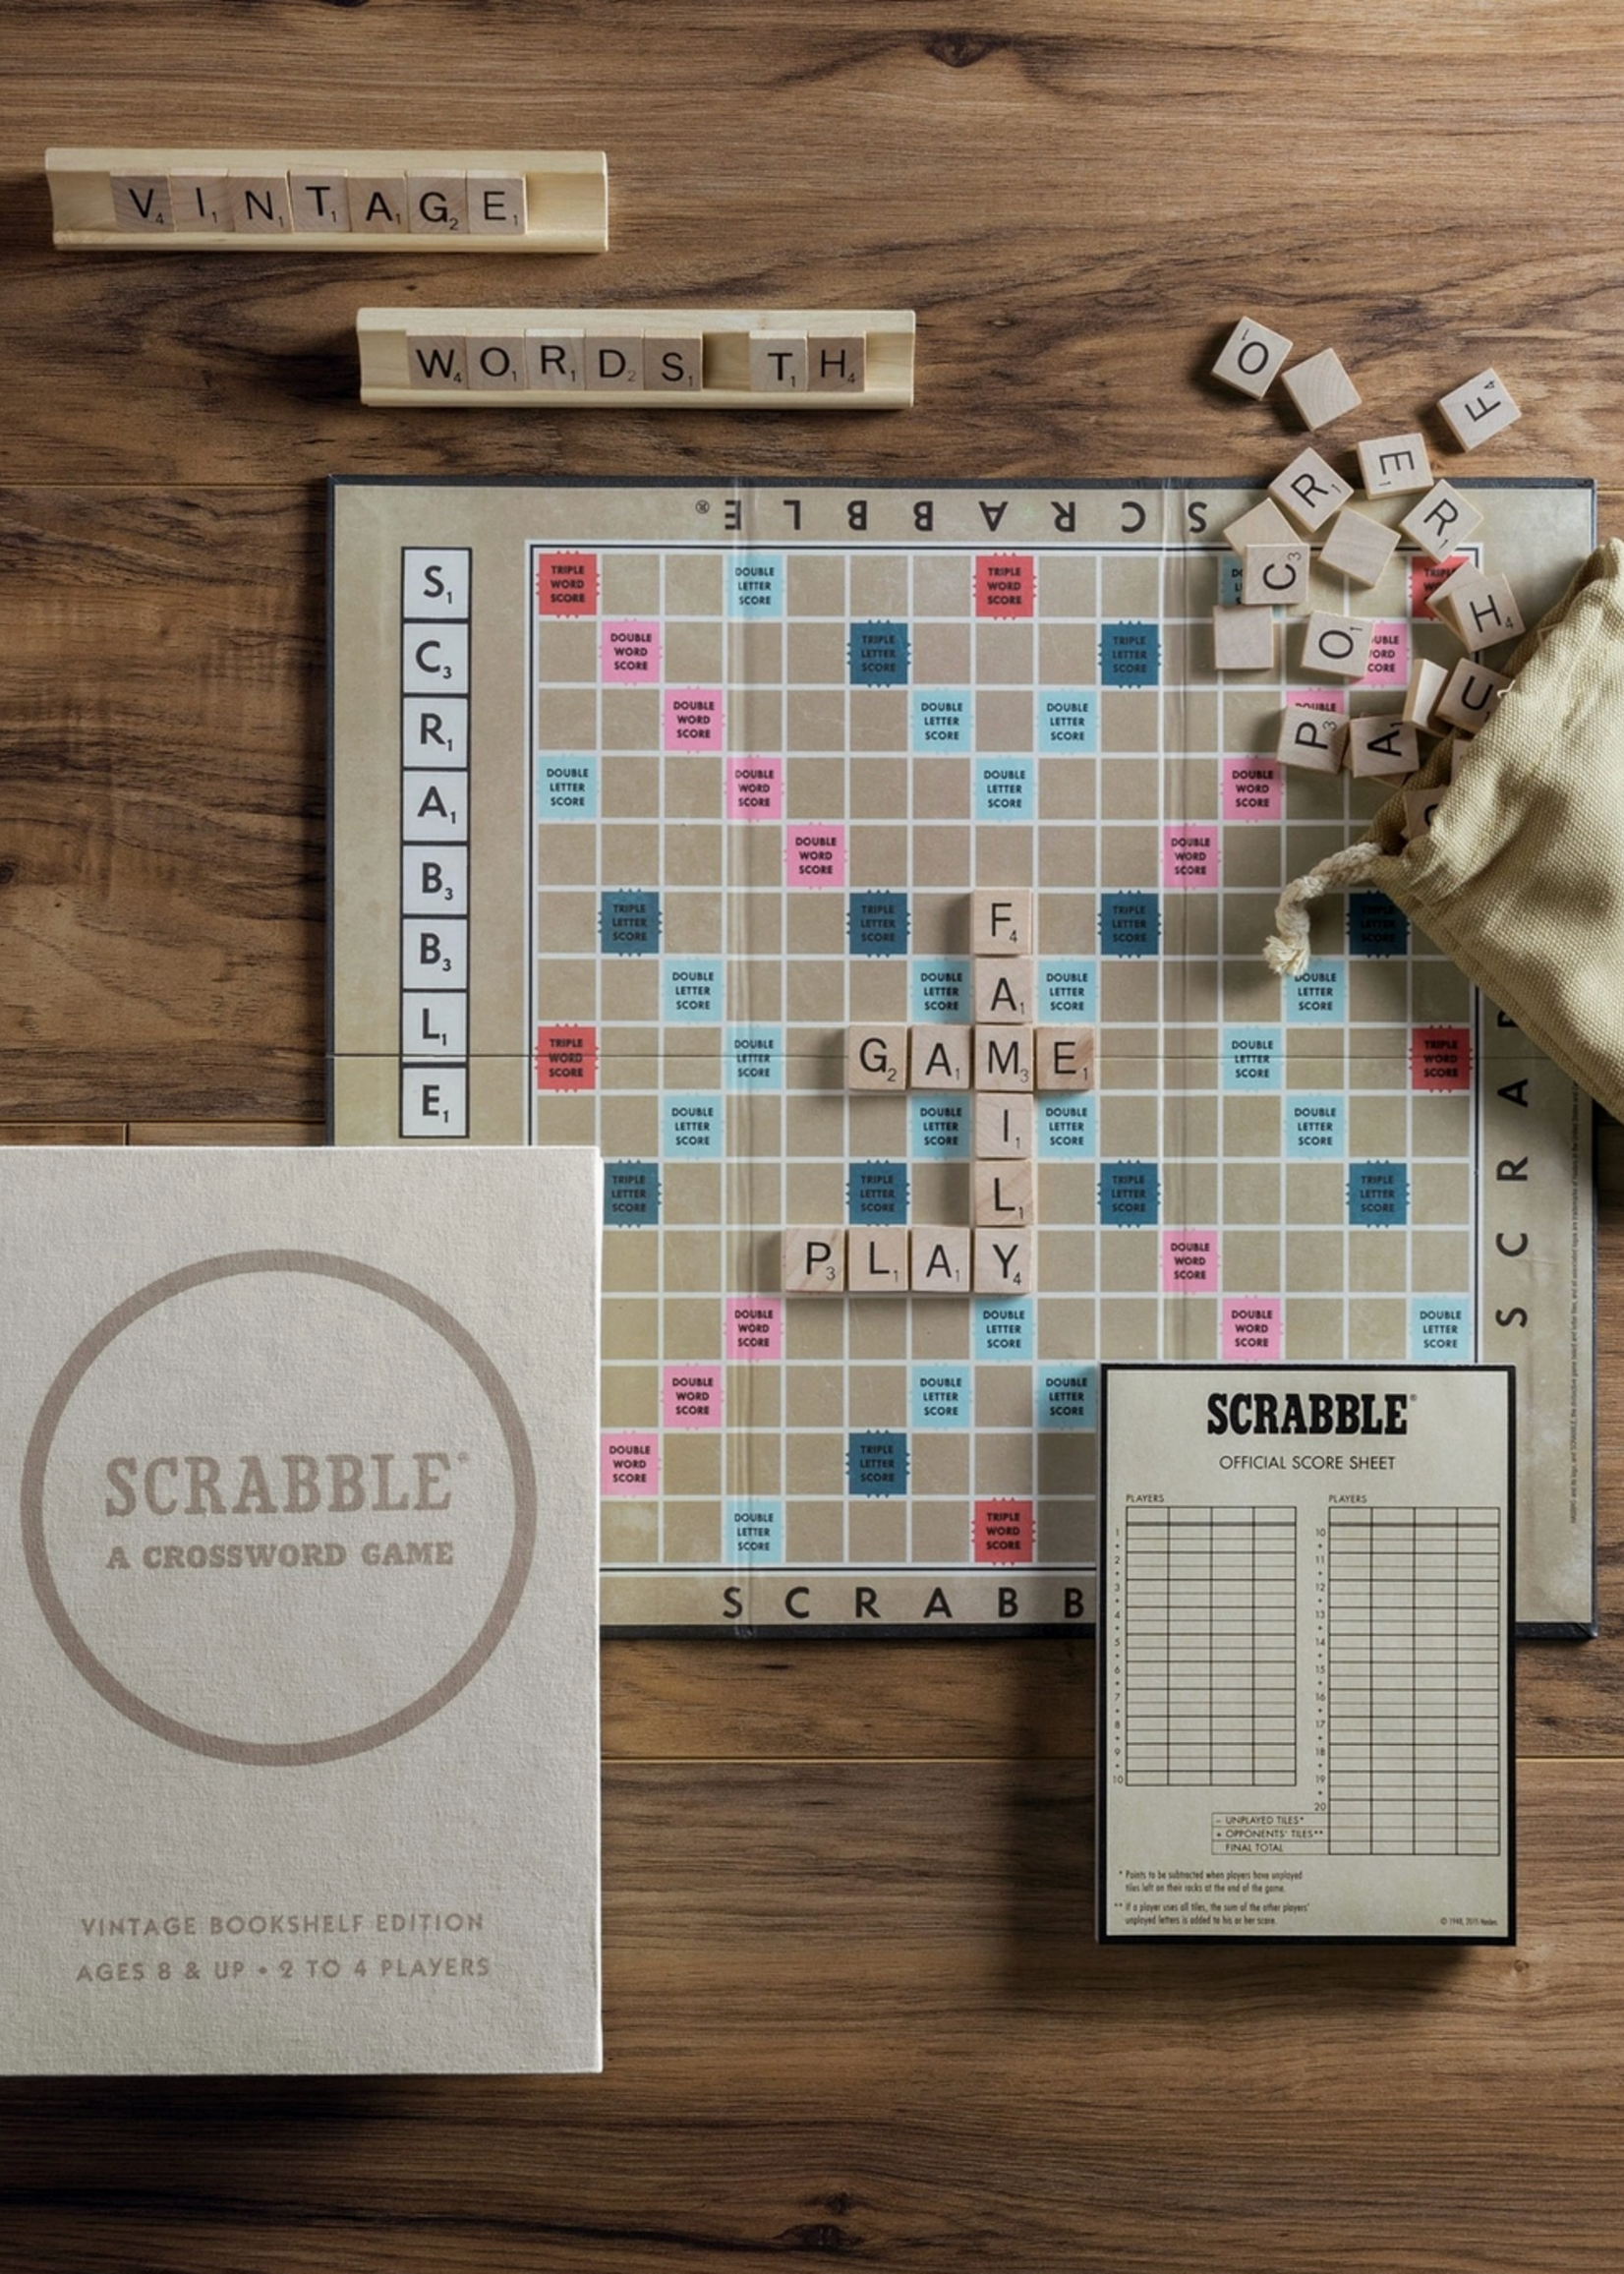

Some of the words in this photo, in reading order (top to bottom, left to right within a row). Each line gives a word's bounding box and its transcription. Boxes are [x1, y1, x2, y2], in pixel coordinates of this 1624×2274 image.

[551, 565, 585, 575] TRIPLE
[735, 566, 775, 577] DOUBLE
[987, 566, 1021, 577] TRIPLE
[550, 579, 585, 590] WORD
[737, 581, 772, 592] LETTER
[986, 581, 1021, 592] WORD
[550, 593, 586, 604] SCORE
[739, 595, 771, 606] SCORE
[987, 595, 1022, 606] SCORE
[609, 632, 652, 643] DOUBLE
[1113, 635, 1146, 646] TRIPLE
[613, 647, 648, 657] WORD
[1112, 650, 1147, 660] LETTER
[613, 661, 648, 671] SCORE
[1113, 663, 1147, 673] SCORE
[920, 702, 963, 713] DOUBLE
[924, 716, 959, 727] LETTER
[924, 730, 959, 740] SCORE
[546, 768, 589, 779] DOUBLE
[1231, 769, 1276, 781] DOUBLE
[550, 782, 586, 792] LETTER
[1235, 784, 1270, 794] WORD
[551, 796, 585, 807] SCORE
[1235, 797, 1270, 808] SCORE
[1171, 837, 1210, 847] DOUBLE
[1175, 851, 1207, 861] WORD
[1174, 865, 1207, 876] SCORE
[612, 904, 646, 913] TRIPLE
[611, 917, 648, 928] LETTER
[612, 931, 648, 942] SCORE
[671, 971, 714, 981] DOUBLE
[675, 985, 711, 996] LETTER
[675, 1000, 711, 1011] SCORE
[1423, 1039, 1460, 1051] TRIPLE
[1422, 1053, 1460, 1065] WORD
[1424, 1067, 1460, 1079] SCORE
[1294, 1107, 1336, 1118] DOUBLE
[1297, 1122, 1333, 1132] LETTER
[1298, 1136, 1333, 1146] SCORE
[1231, 1310, 1273, 1319] DOUBLE
[1420, 1310, 1462, 1320] DOUBLE
[1235, 1323, 1269, 1334] WORD
[1422, 1324, 1458, 1334] LETTER
[1235, 1337, 1269, 1348] SCORE
[1423, 1339, 1458, 1349] SCORE
[671, 1377, 714, 1387] DOUBLE
[675, 1391, 710, 1401] WORD
[675, 1405, 710, 1416] SCORE
[1219, 1455, 1286, 1470] OFFICIAL
[1292, 1455, 1344, 1470] SCORE
[1350, 1455, 1396, 1470] SHEET
[1126, 1493, 1165, 1503] PLAYERS
[1328, 1494, 1367, 1503] PLAYERS
[986, 1512, 1020, 1522] TRIPLE
[986, 1526, 1021, 1537] WORD
[1315, 1528, 1326, 1537] 10
[986, 1540, 1021, 1550] SCORE
[105, 1545, 130, 1570] A
[143, 1543, 346, 1569] CROSSWORD
[361, 1542, 454, 1566] GAME
[1315, 1555, 1326, 1564] 11
[1315, 1583, 1326, 1592] 12
[1315, 1637, 1326, 1647] 14
[1315, 1664, 1326, 1674] 15
[1315, 1692, 1326, 1702] 16
[1315, 1720, 1326, 1728] 17
[1315, 1775, 1326, 1783] 19
[1313, 1802, 1327, 1812] 20
[1225, 1816, 1274, 1825] UNPLAYED
[1225, 1843, 1252, 1852] FINAL
[1255, 1843, 1284, 1852] TOTAL
[81, 1916, 197, 1937] VINTAGE
[210, 1914, 364, 1935] BOOKSHELF
[377, 1912, 485, 1933] EDITION
[77, 1961, 145, 1982] AGES
[157, 1961, 171, 1981] 8
[183, 1960, 201, 1981] &
[214, 1960, 245, 1980] UP
[279, 1959, 294, 1979] 2
[308, 1958, 340, 1979] TO
[354, 1958, 367, 1977] 4
[380, 1957, 490, 1977] PLAYERS
